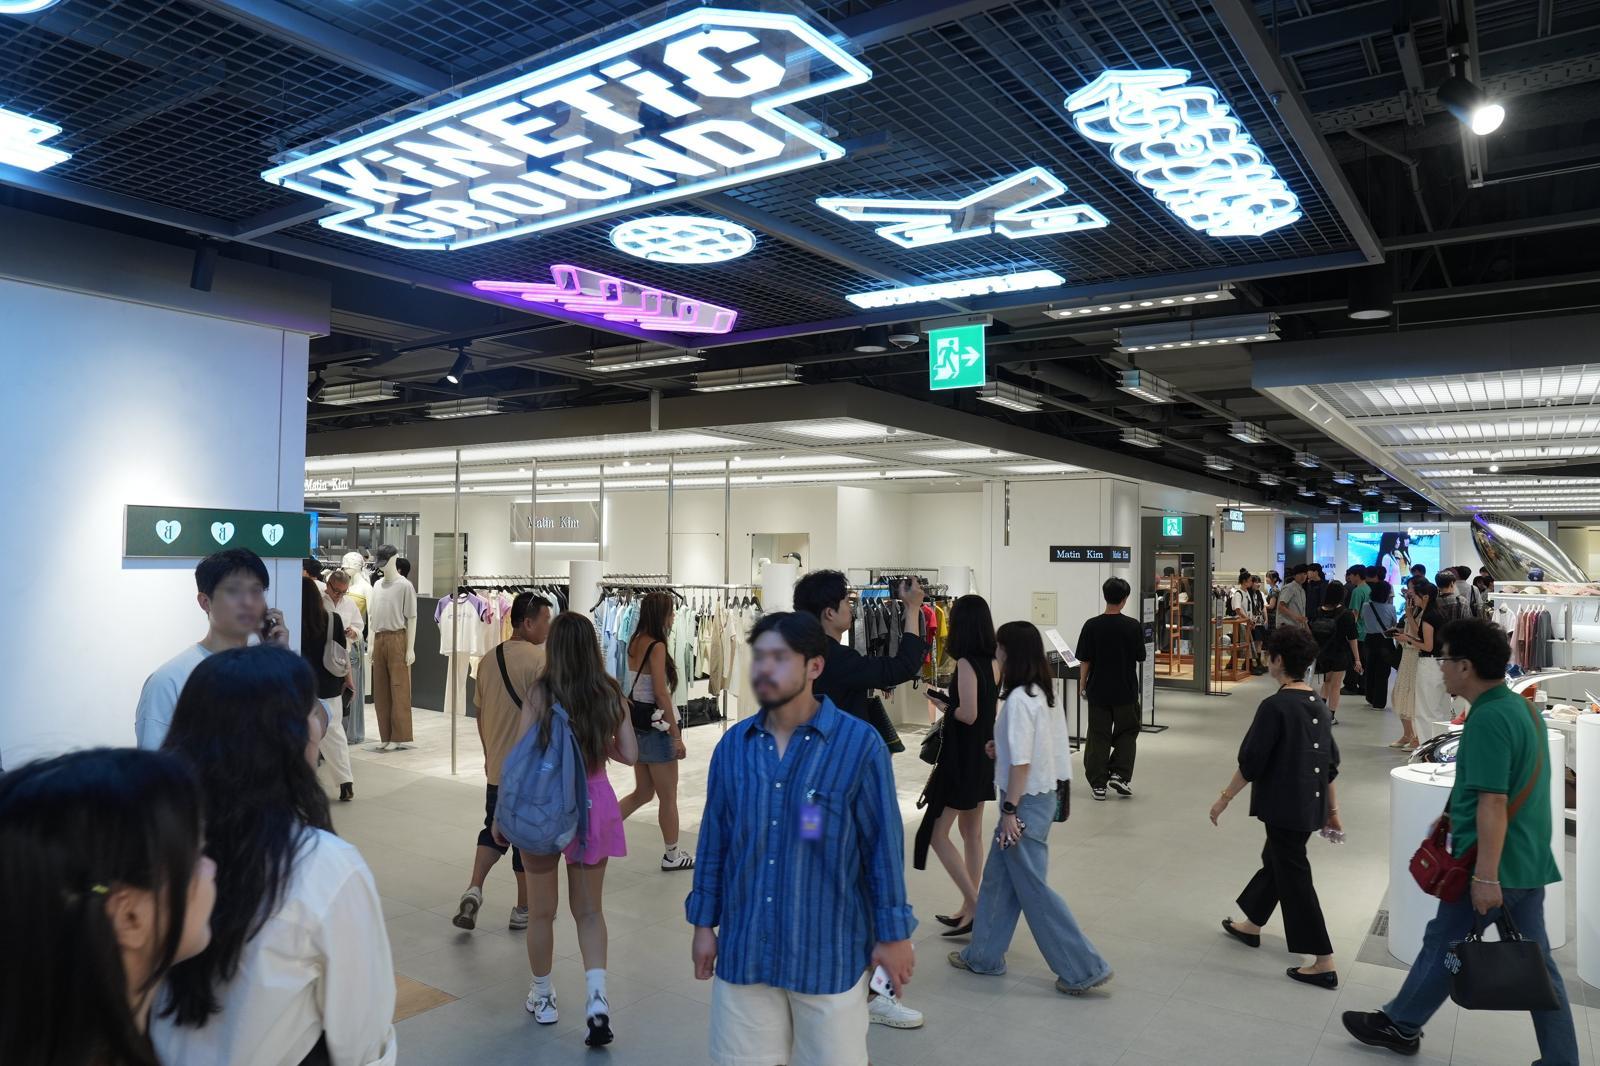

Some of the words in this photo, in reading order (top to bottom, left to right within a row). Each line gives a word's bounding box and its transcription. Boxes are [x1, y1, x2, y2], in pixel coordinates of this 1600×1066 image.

[358, 119, 786, 238] GROUND
[559, 515, 580, 528] Kim
[1056, 550, 1081, 559] Matin
[1086, 549, 1104, 559] Kim
